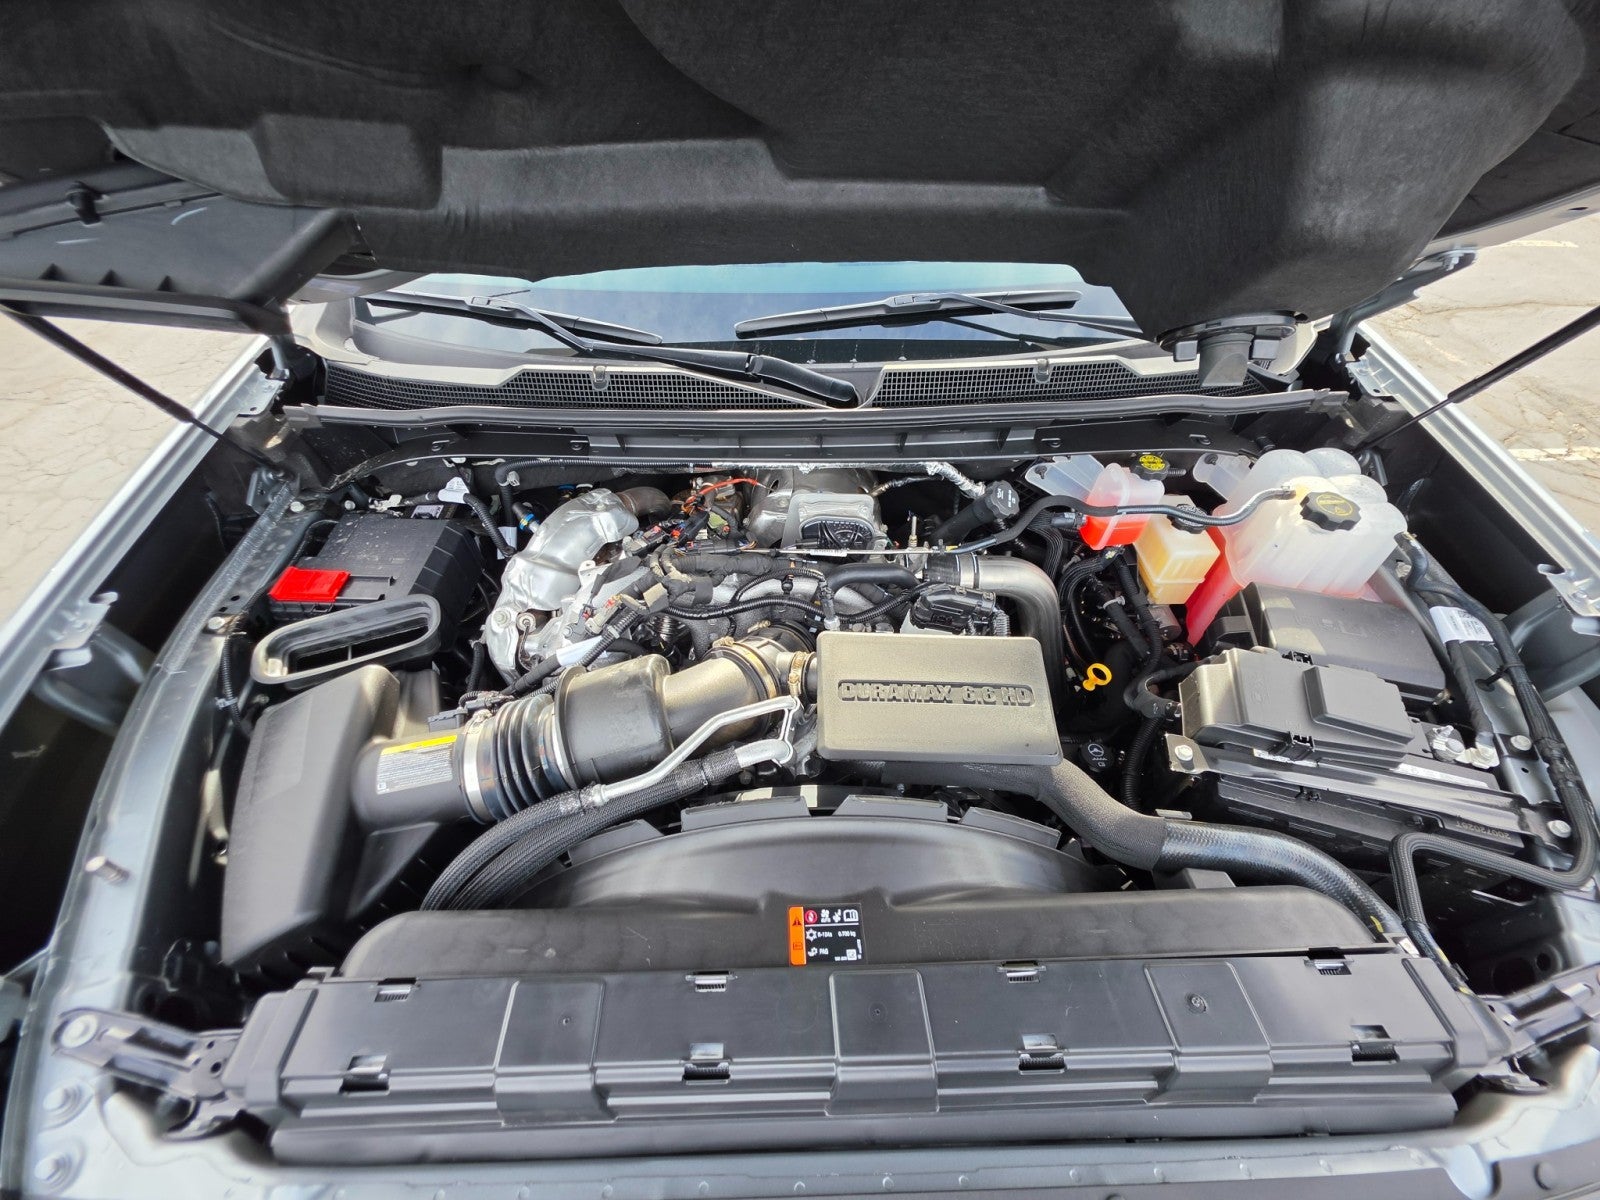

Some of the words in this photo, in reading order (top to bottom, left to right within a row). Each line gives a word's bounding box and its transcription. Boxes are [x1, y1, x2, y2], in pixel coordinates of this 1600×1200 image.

[841, 682, 953, 704] DURAMAX
[961, 685, 997, 706] 6.6
[1000, 686, 1032, 707] HD
